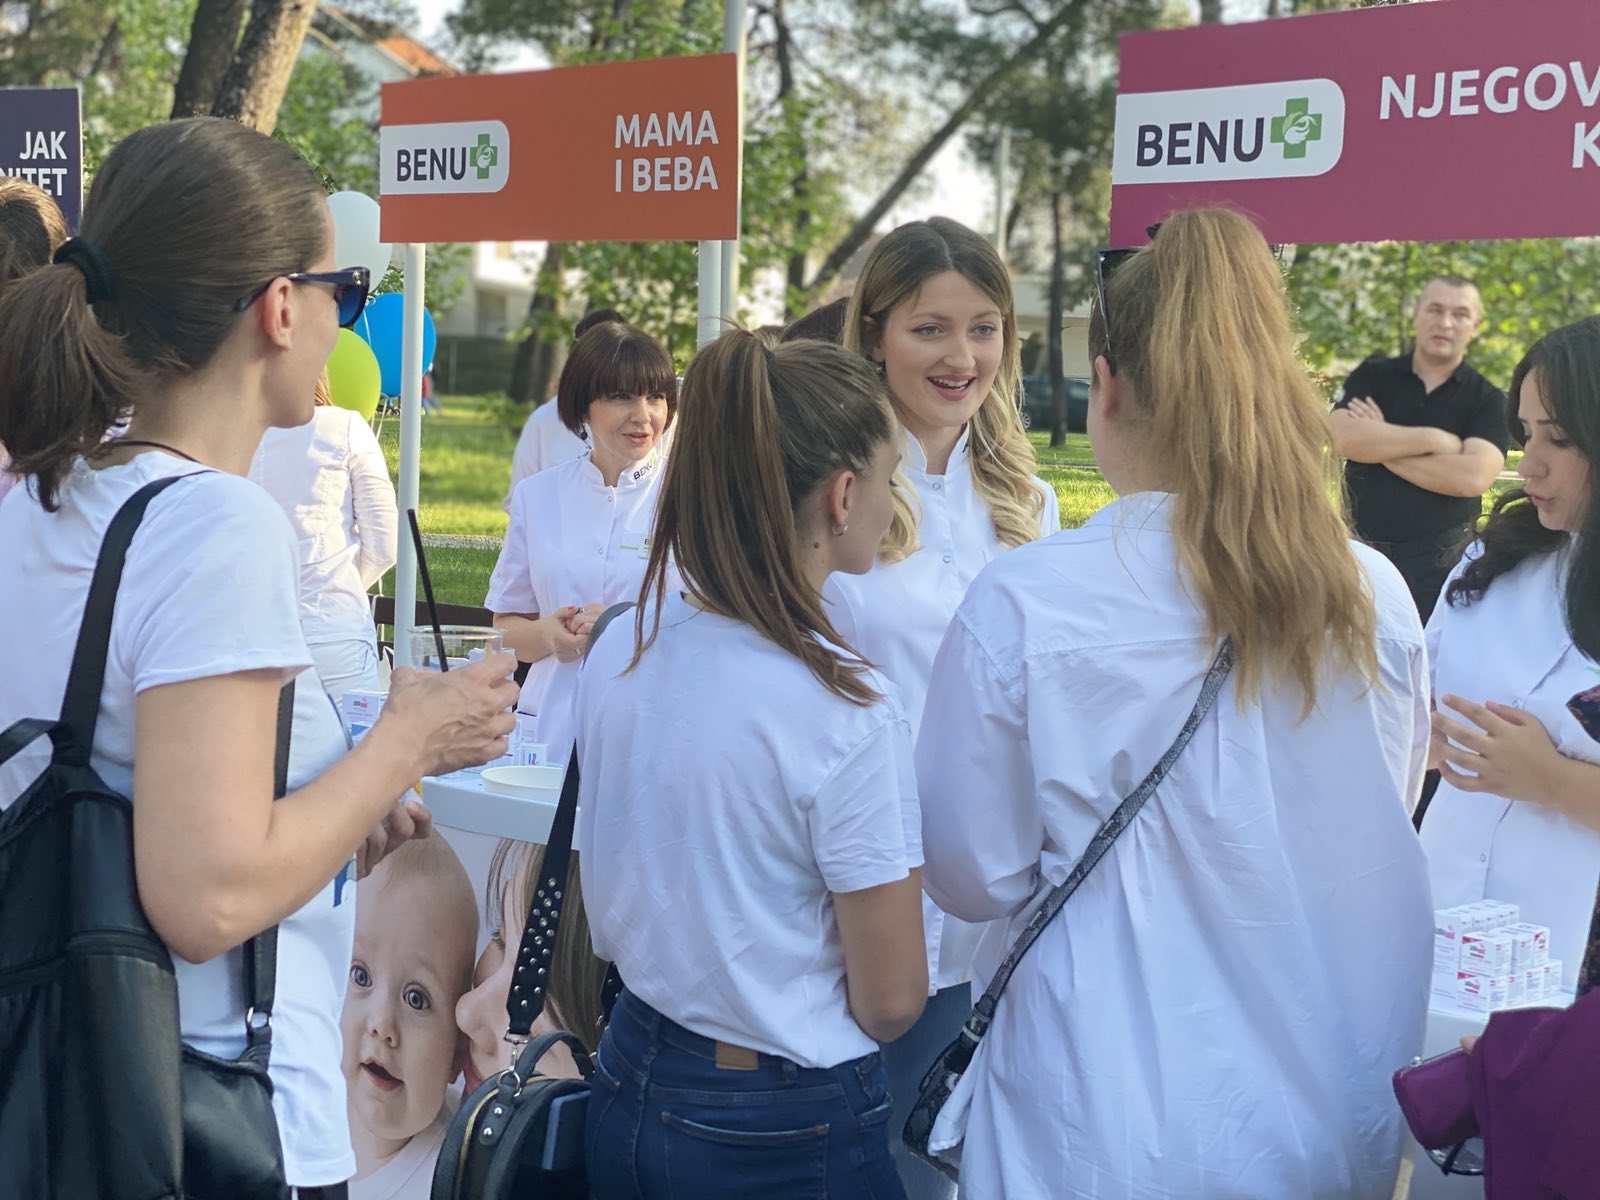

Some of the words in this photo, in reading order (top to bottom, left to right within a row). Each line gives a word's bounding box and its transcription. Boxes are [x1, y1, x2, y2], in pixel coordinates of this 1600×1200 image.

[1379, 61, 1600, 120] NJEGOV
[19, 131, 67, 160] JAK
[614, 110, 719, 149] MAMA
[1136, 117, 1265, 167] BENU
[0, 167, 68, 196] TET
[396, 146, 467, 182] BENU
[614, 159, 623, 193] I
[632, 156, 719, 193] BEBA
